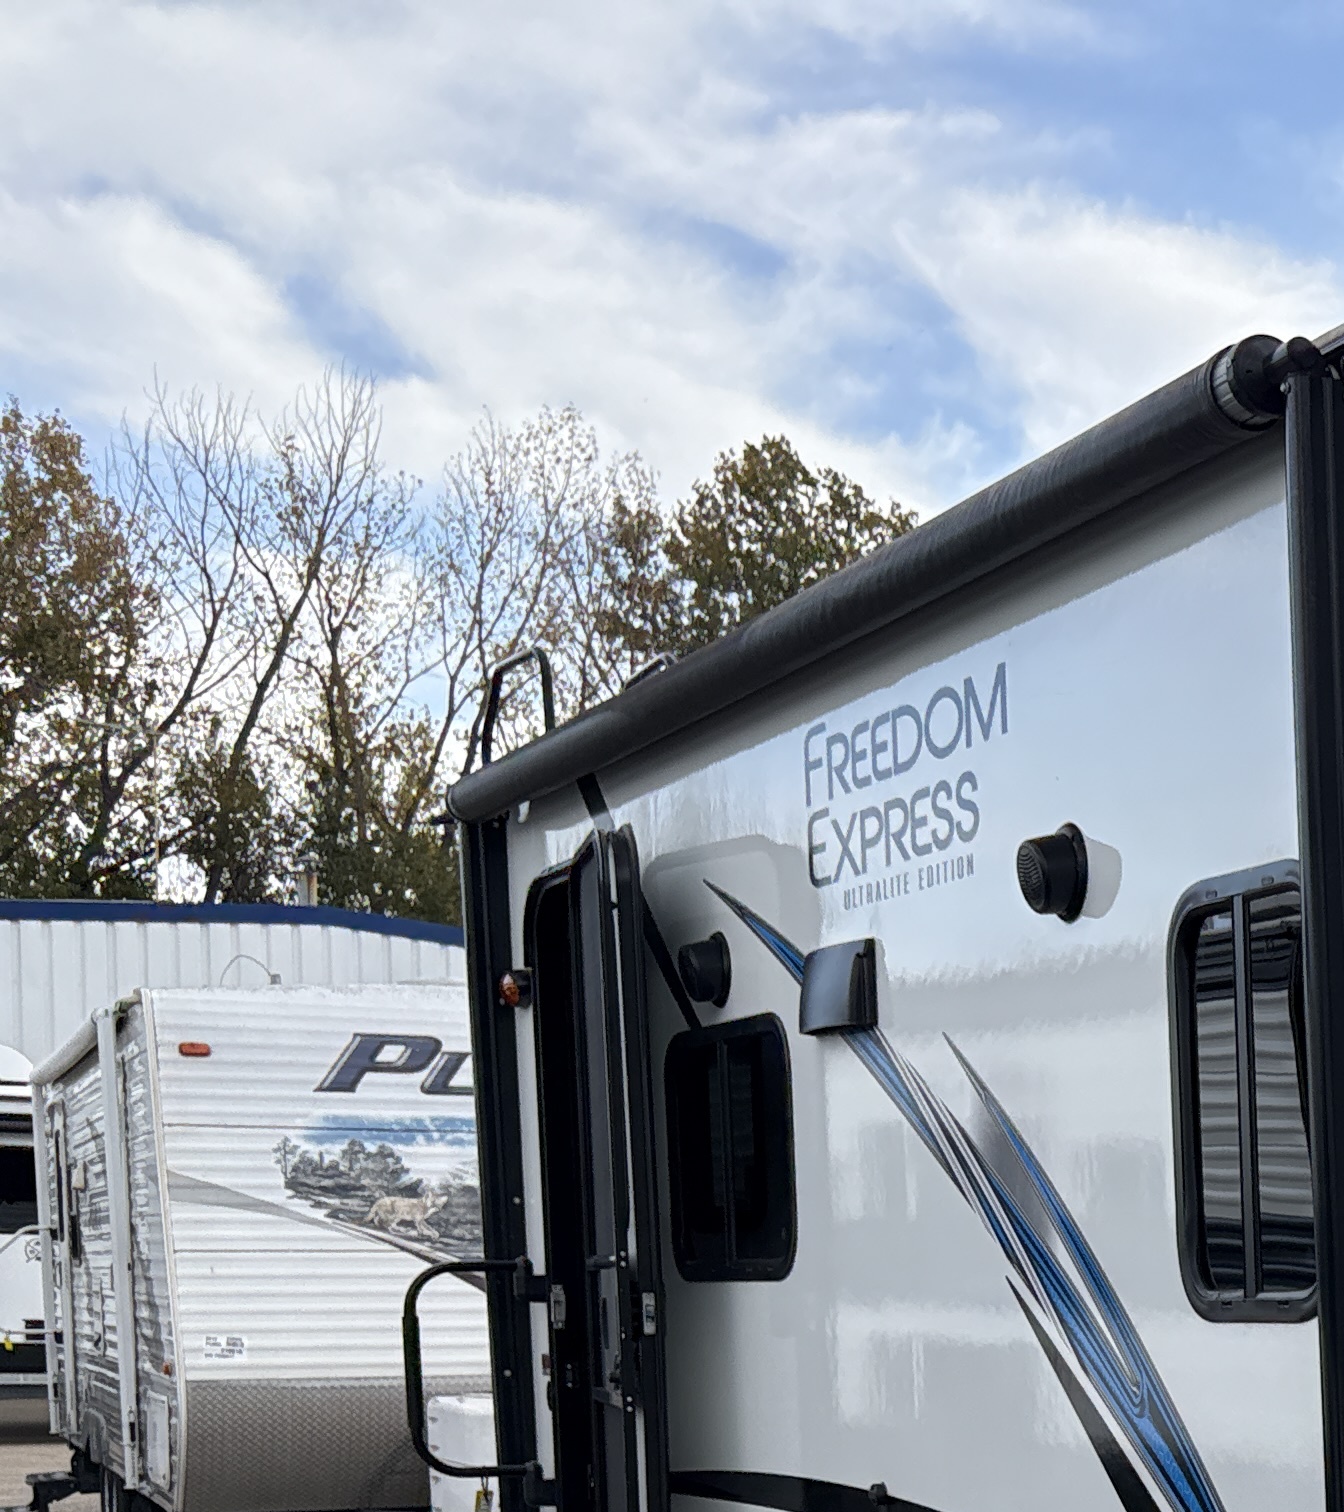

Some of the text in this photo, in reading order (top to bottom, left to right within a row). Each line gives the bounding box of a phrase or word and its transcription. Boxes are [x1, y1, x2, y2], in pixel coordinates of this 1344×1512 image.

[803, 661, 1009, 806] FREEDOM
[807, 770, 981, 888] EXPRESS
[843, 853, 975, 912] ULTRALITE EDITION
